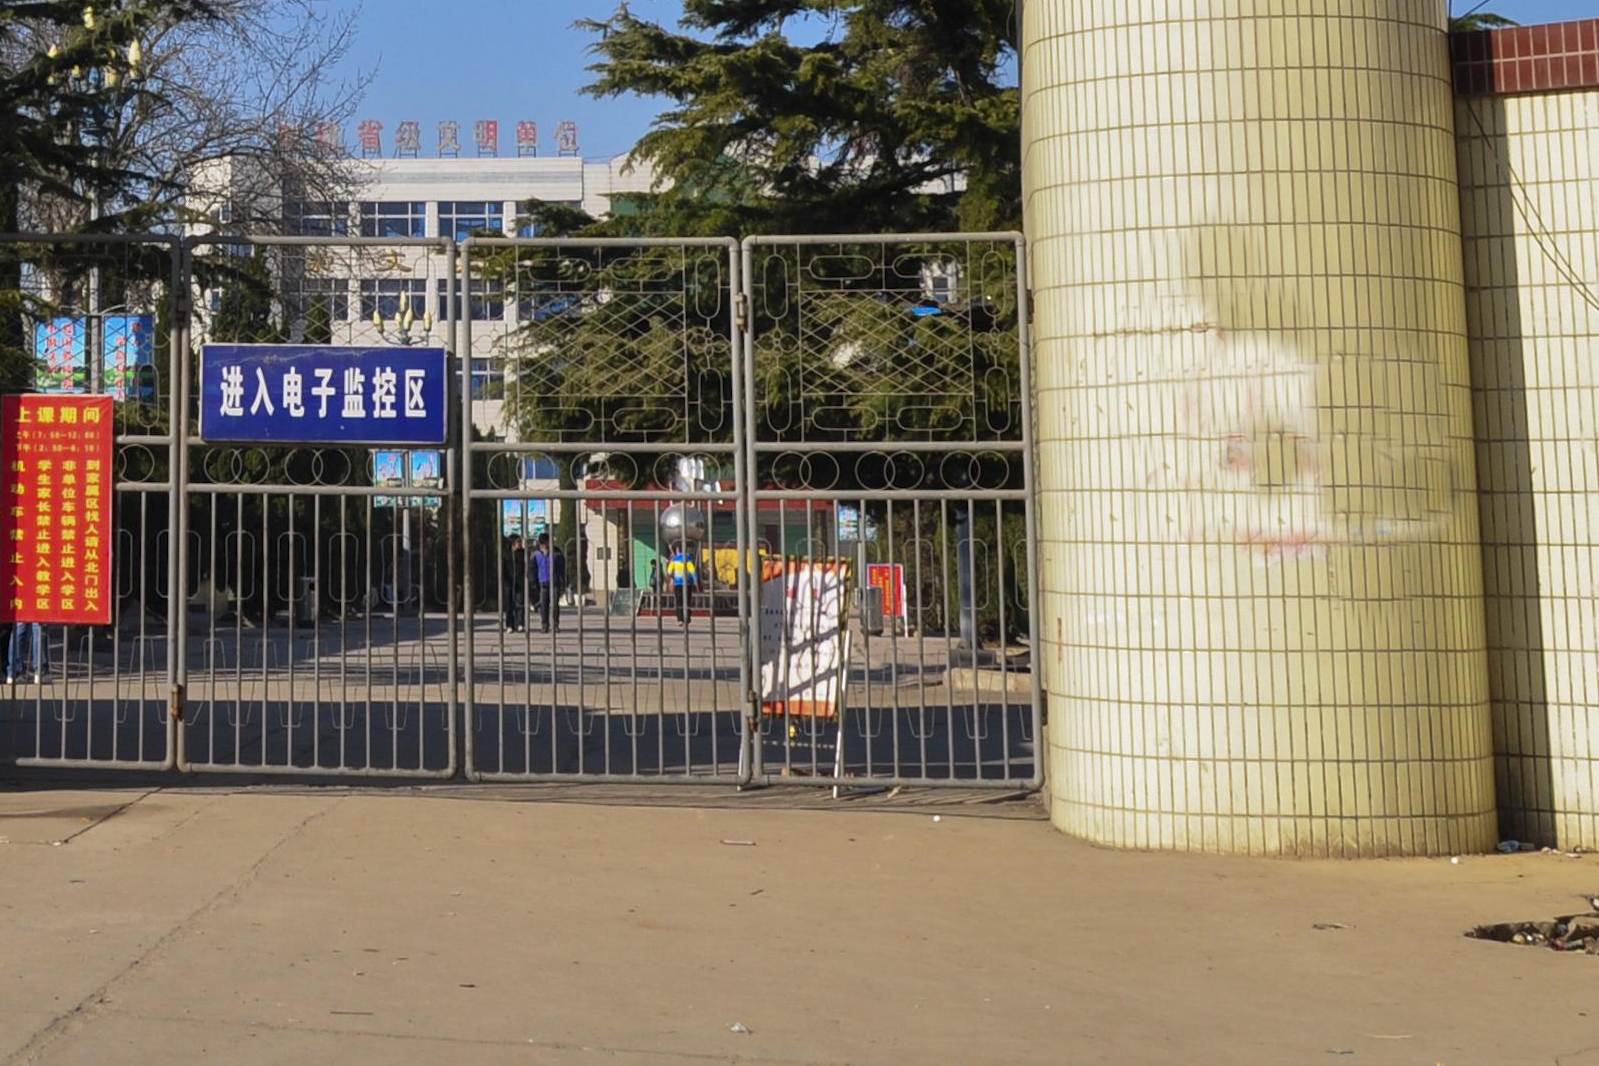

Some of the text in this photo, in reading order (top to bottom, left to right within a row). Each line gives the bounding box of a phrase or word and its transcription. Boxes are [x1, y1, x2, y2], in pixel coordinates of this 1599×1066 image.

[14, 406, 100, 424] 上课期间
[219, 365, 427, 419] 进入电子监控区
[9, 459, 26, 611] 机动车禁止入内
[36, 459, 52, 611] 学生家长禁止进入教学区
[60, 459, 77, 611] 非单位车辆禁止进入学区
[84, 459, 100, 612] 到家属区找人请从北门出入
